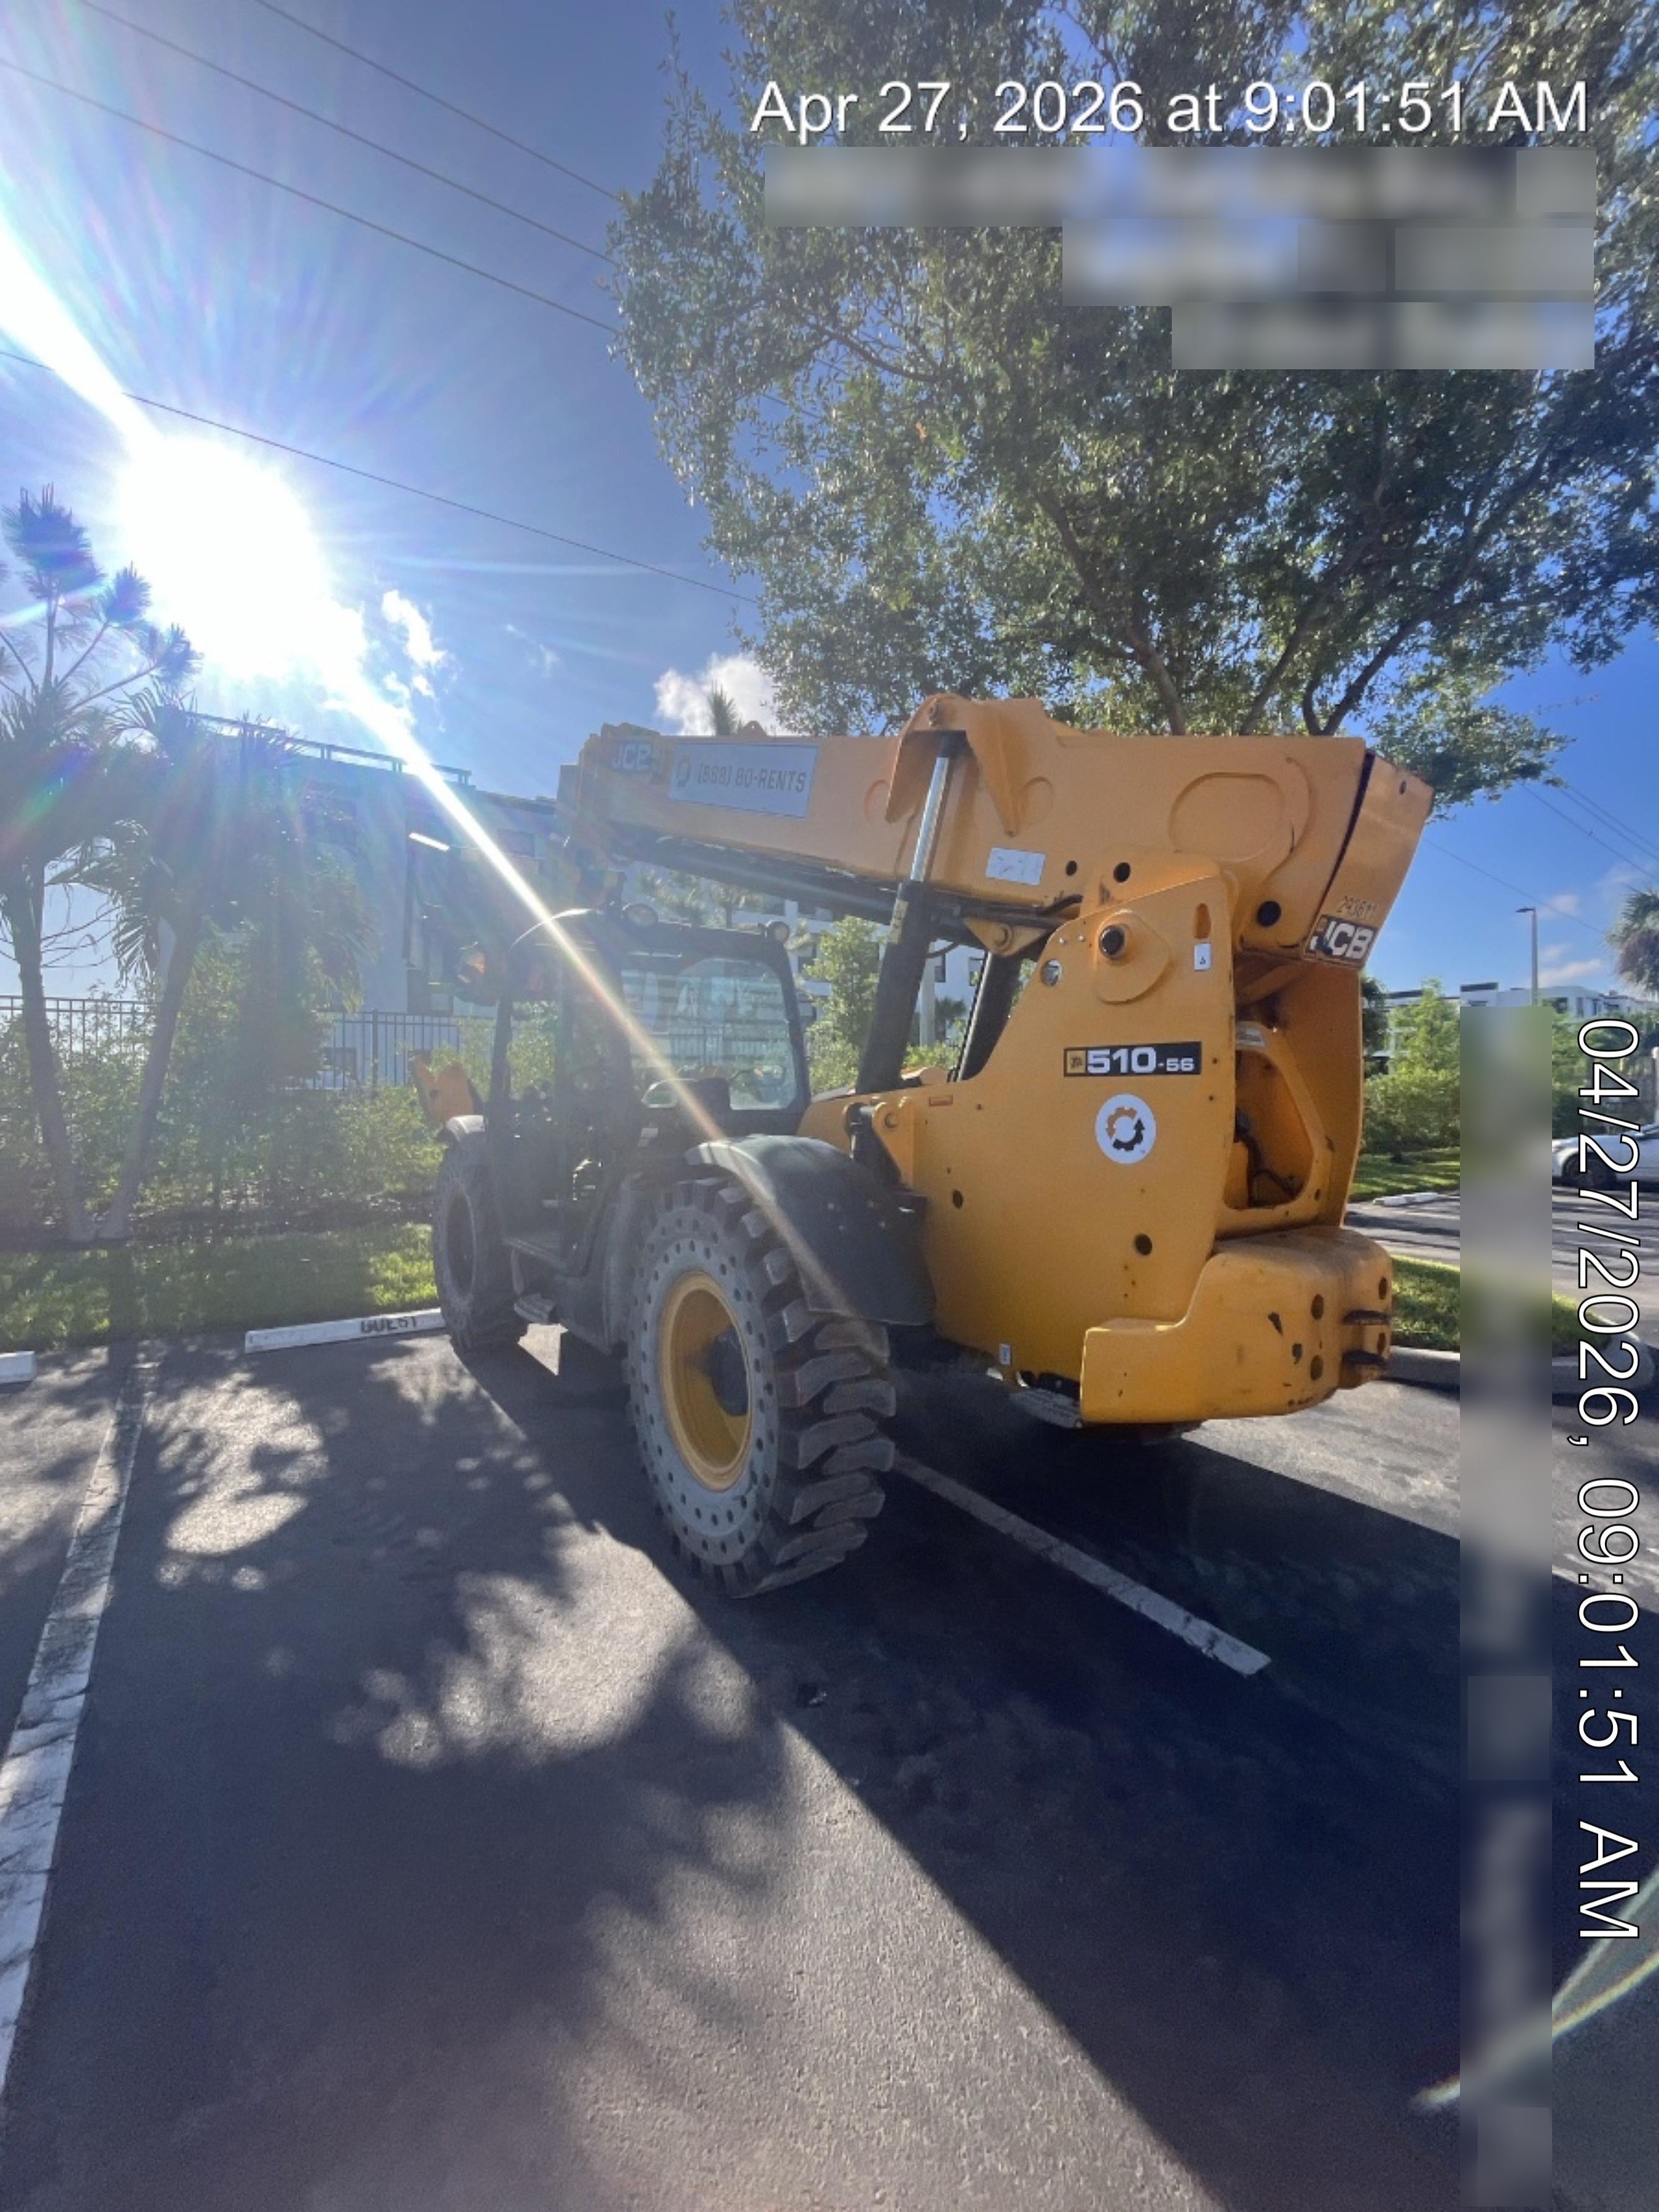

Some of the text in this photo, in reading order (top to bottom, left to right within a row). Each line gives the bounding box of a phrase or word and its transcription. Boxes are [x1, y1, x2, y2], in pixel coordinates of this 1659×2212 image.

[611, 742, 653, 772] JCB
[735, 767, 807, 793] 80-RENTS
[361, 1316, 417, 1333] GUEST
